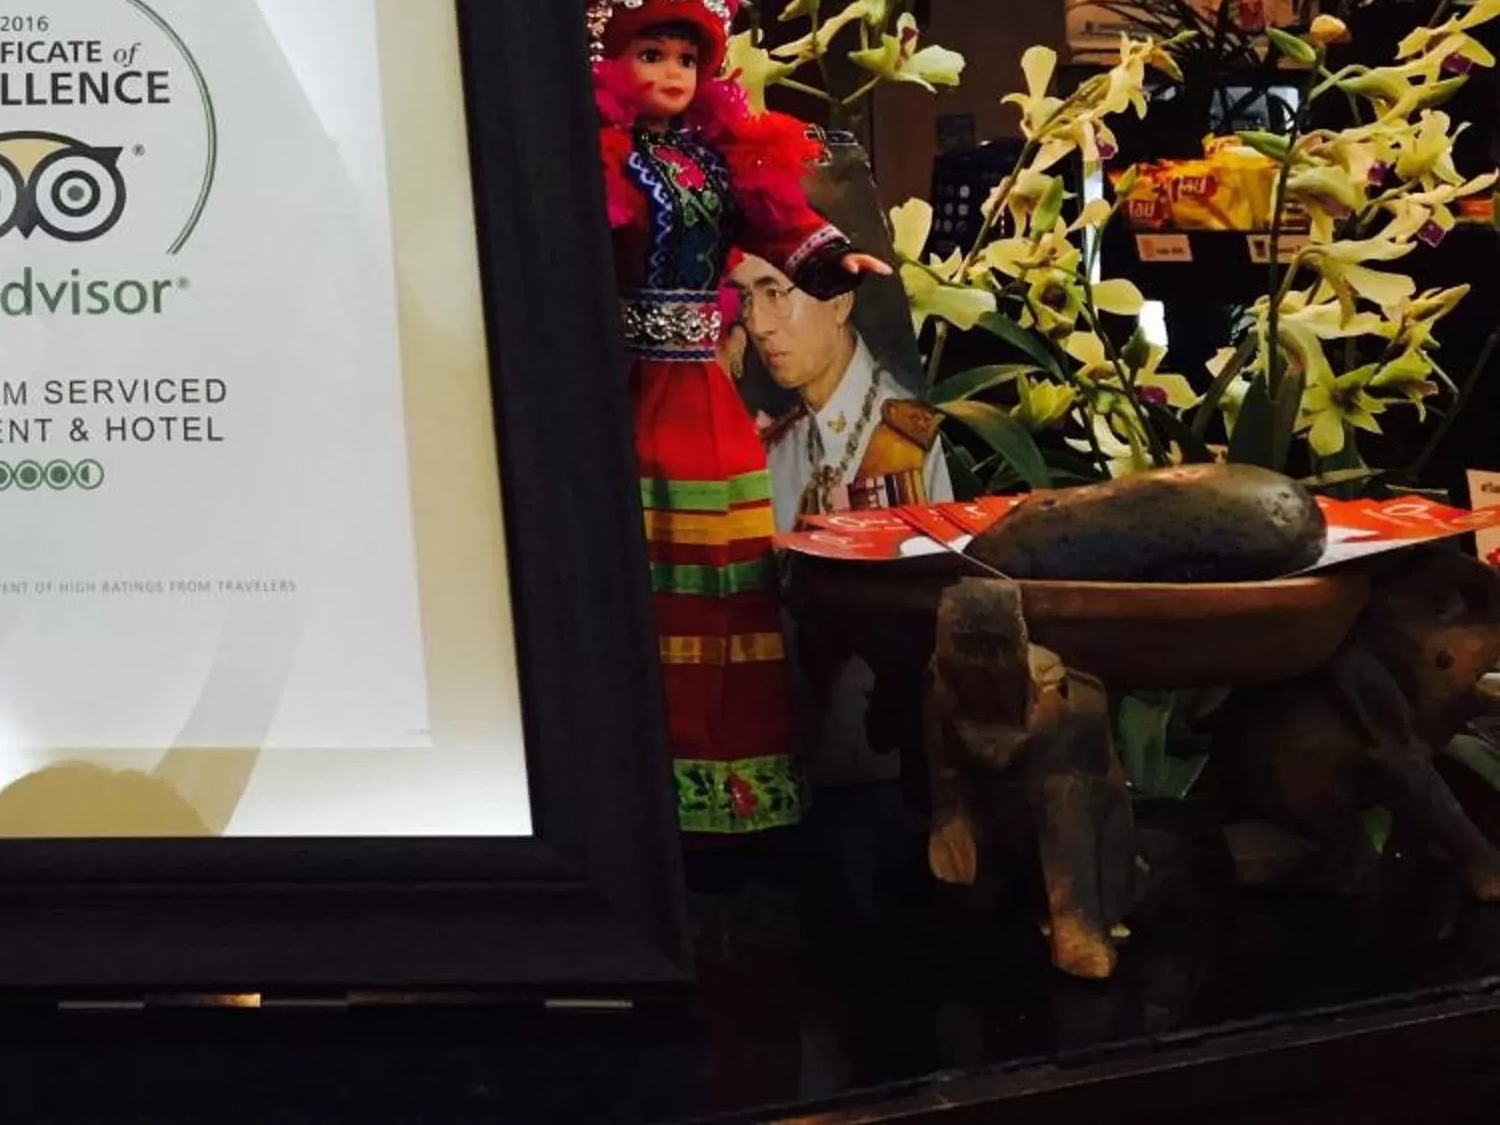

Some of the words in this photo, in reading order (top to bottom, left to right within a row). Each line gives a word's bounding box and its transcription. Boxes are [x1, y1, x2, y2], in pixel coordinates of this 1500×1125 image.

[0, 15, 49, 32] 2016
[112, 41, 142, 68] of
[43, 378, 228, 405] SERVICED
[68, 416, 90, 443] &
[105, 415, 226, 443] HOTEL
[35, 581, 52, 595] OF
[58, 581, 97, 595] HIGH
[101, 580, 164, 595] RATINGS
[169, 579, 211, 594] FROM
